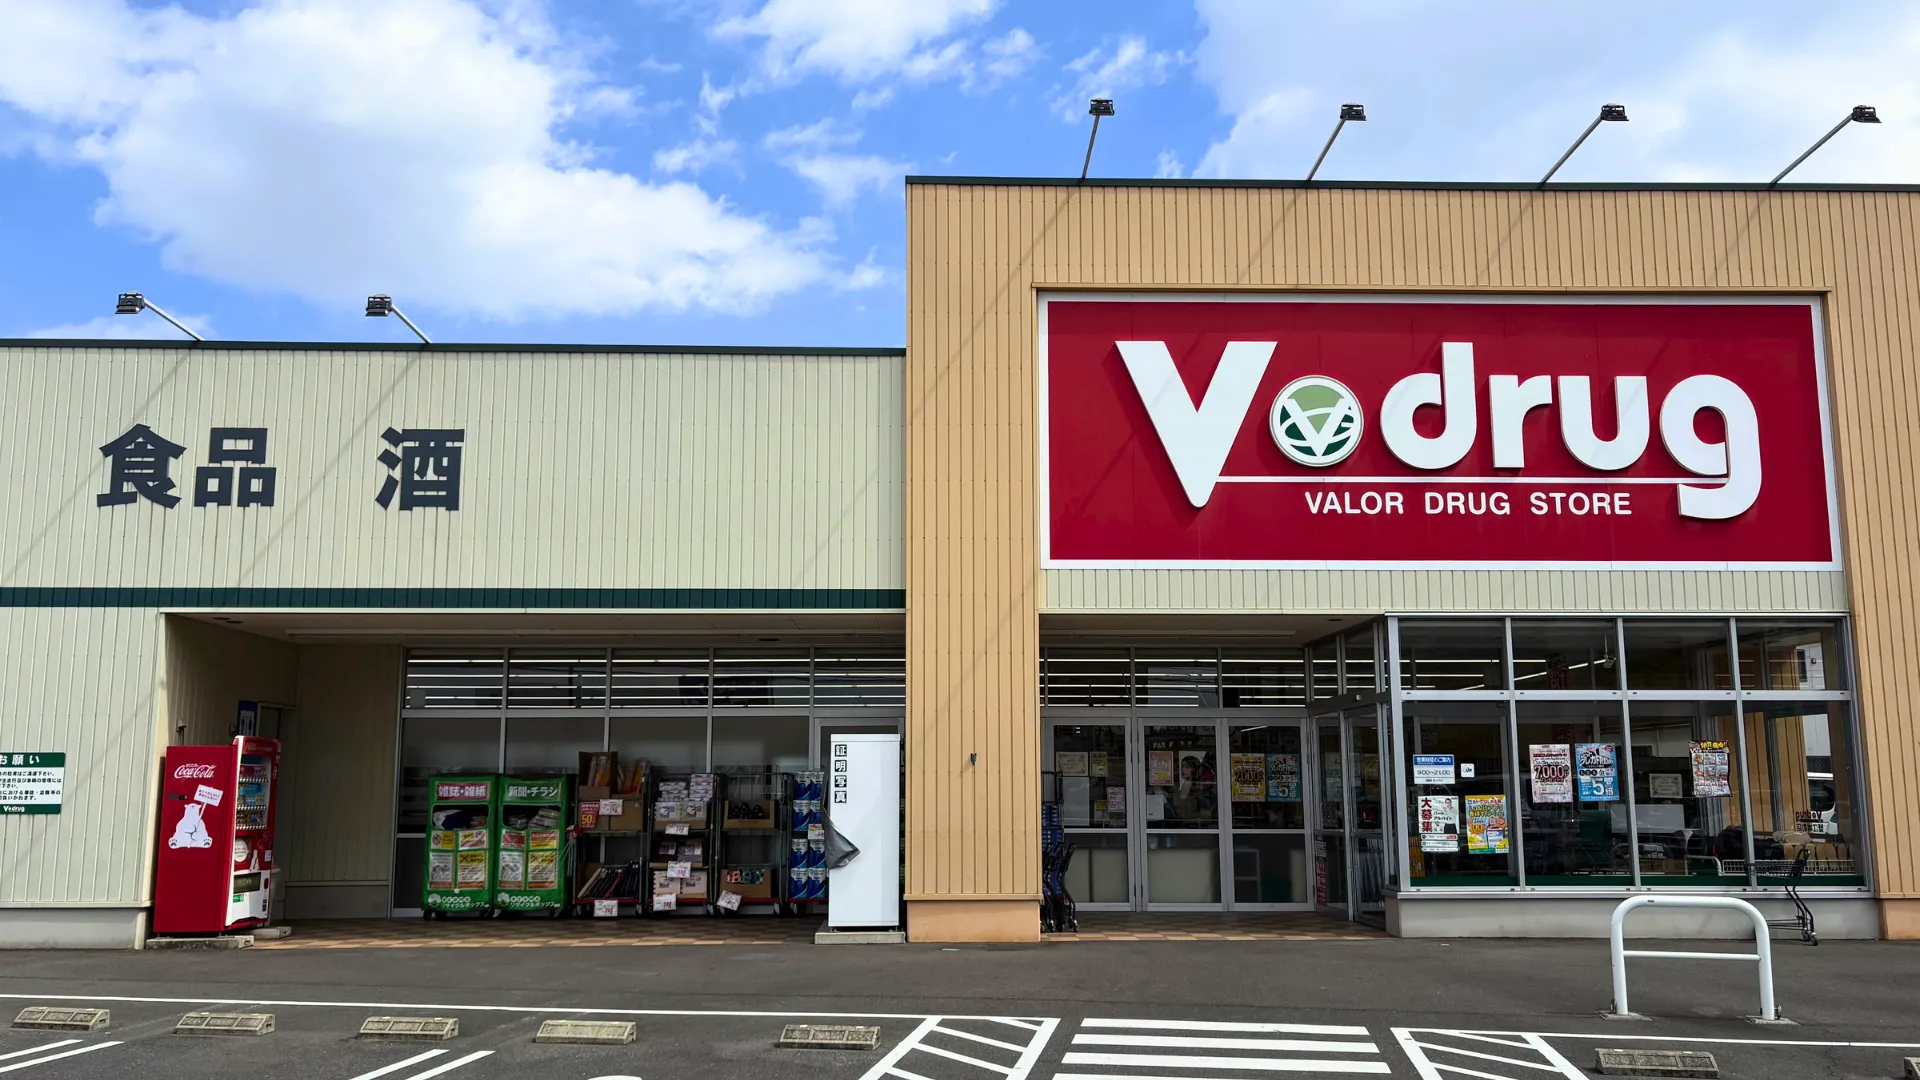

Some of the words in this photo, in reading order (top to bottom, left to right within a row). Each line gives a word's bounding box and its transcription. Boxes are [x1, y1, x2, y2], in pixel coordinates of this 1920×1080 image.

[97, 424, 276, 509] 食品
[375, 427, 464, 511] 酒
[1305, 491, 1404, 516] VALOR
[1425, 491, 1511, 516] DRUG
[1530, 491, 1632, 516] STORE
[174, 764, 217, 779] Coca-Cola
[835, 744, 847, 803] 証明写真
[1421, 797, 1433, 833] 大募集
